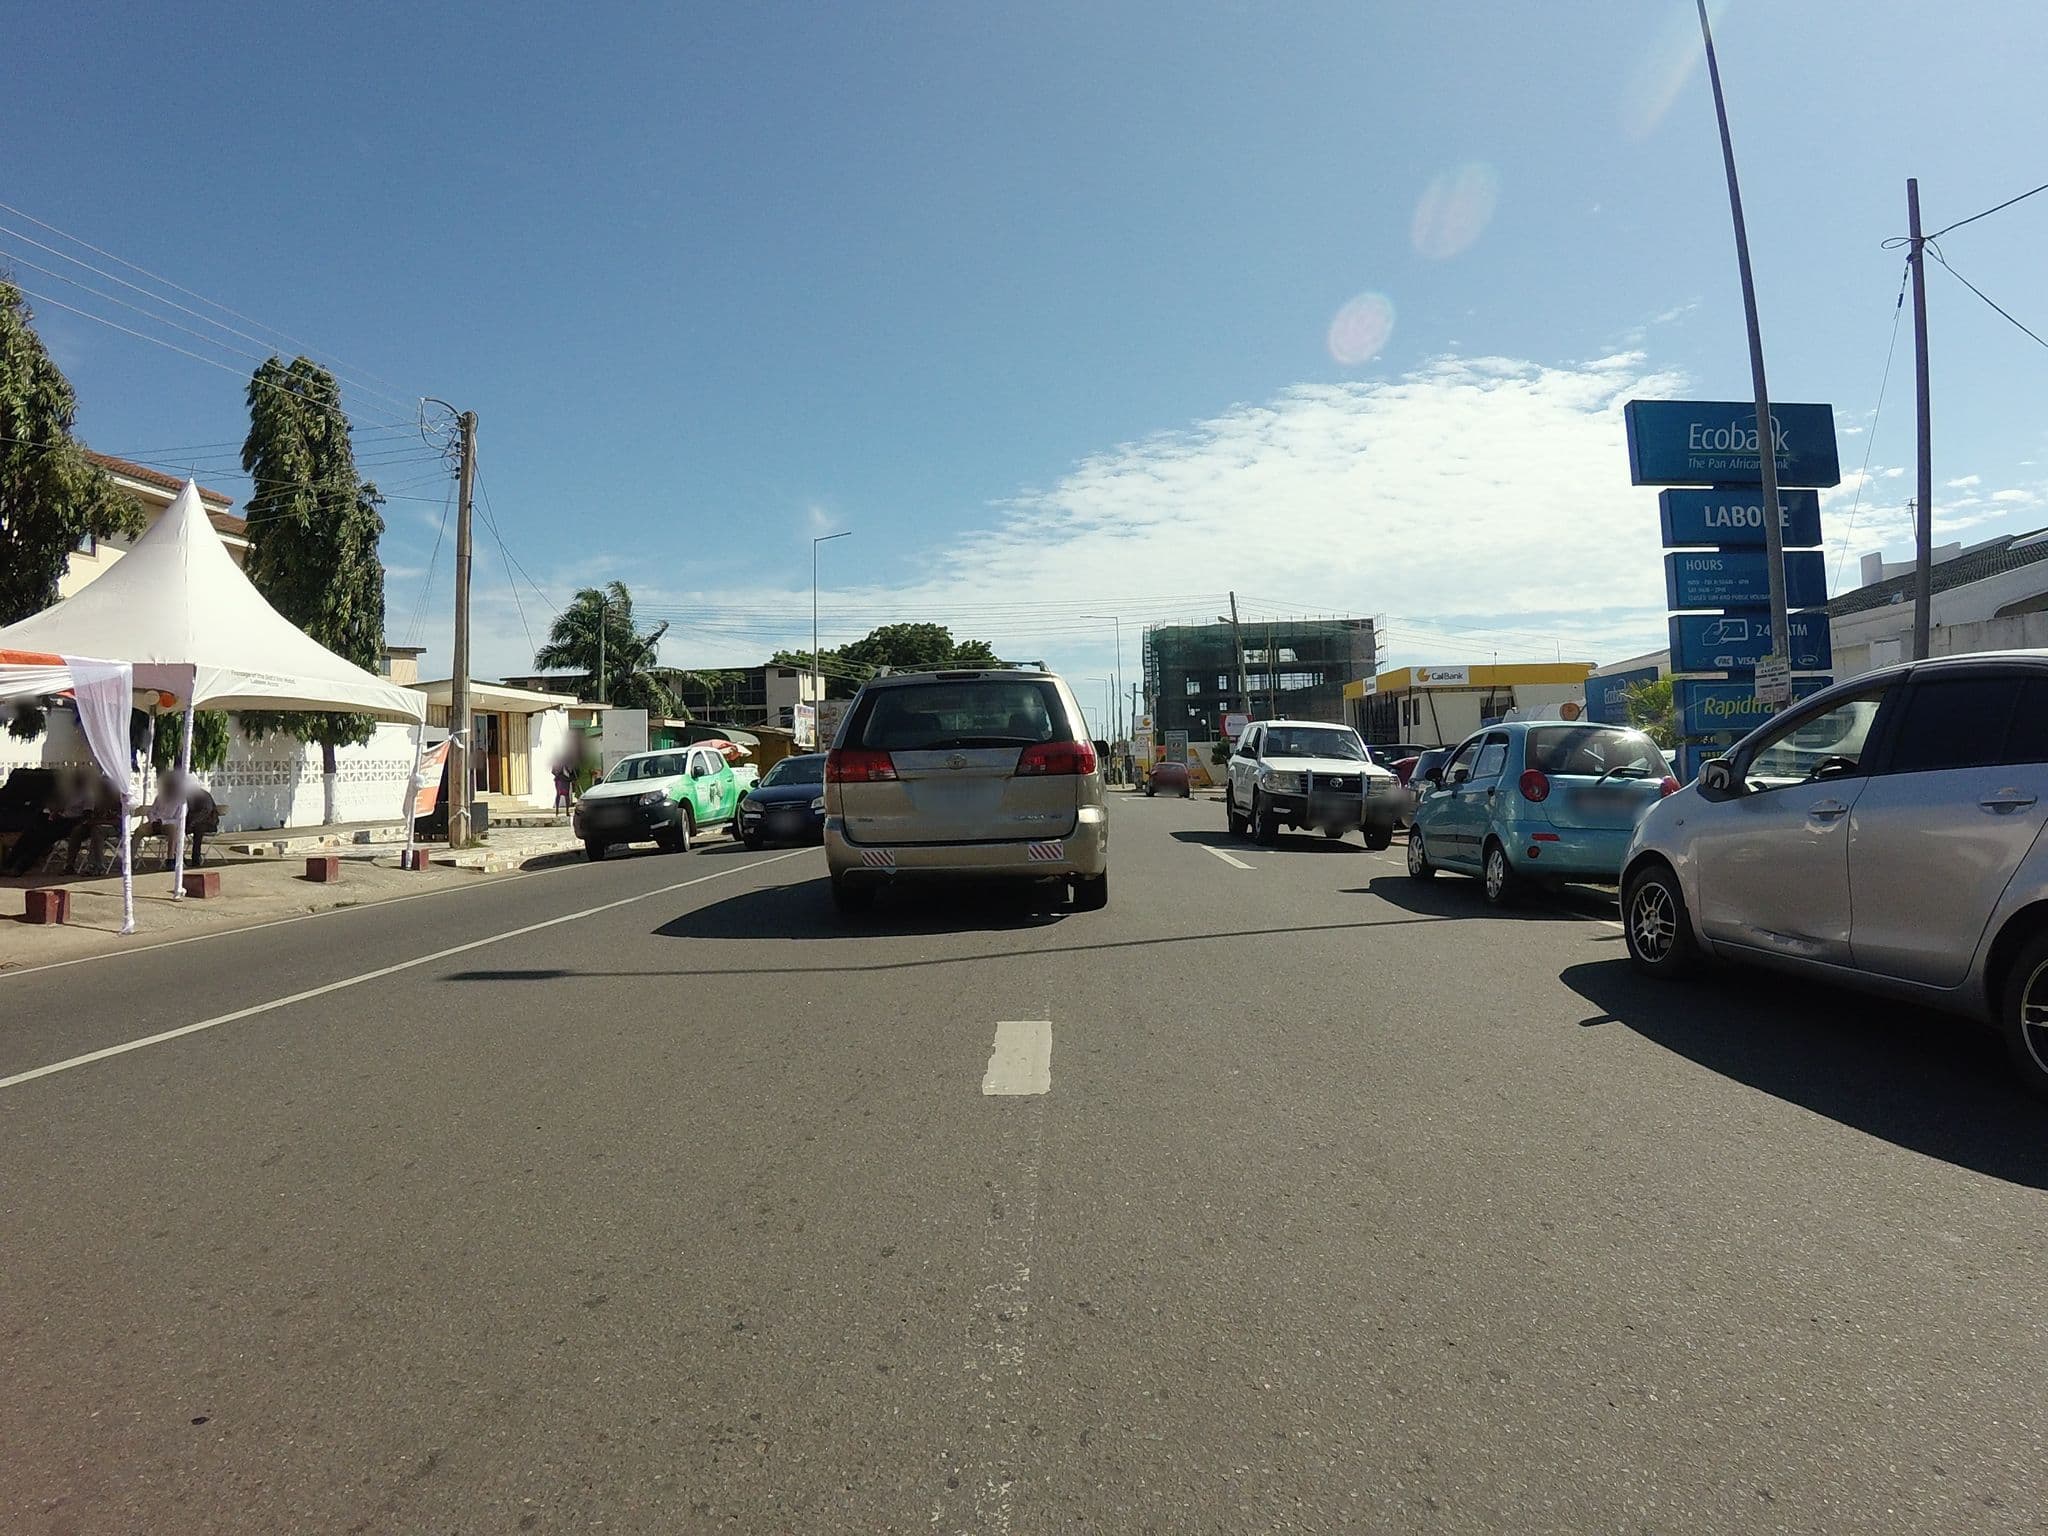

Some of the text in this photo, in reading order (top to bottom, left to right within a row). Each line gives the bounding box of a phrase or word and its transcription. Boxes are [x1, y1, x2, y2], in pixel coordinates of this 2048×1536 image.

[1688, 418, 1790, 451] Ecobak
[1688, 458, 1706, 469] The
[1708, 458, 1726, 469] Pan
[1705, 505, 1790, 528] LABOE
[1686, 559, 1723, 571] HOURS
[1738, 656, 1757, 665] VISA
[1431, 672, 1464, 681] CalBank
